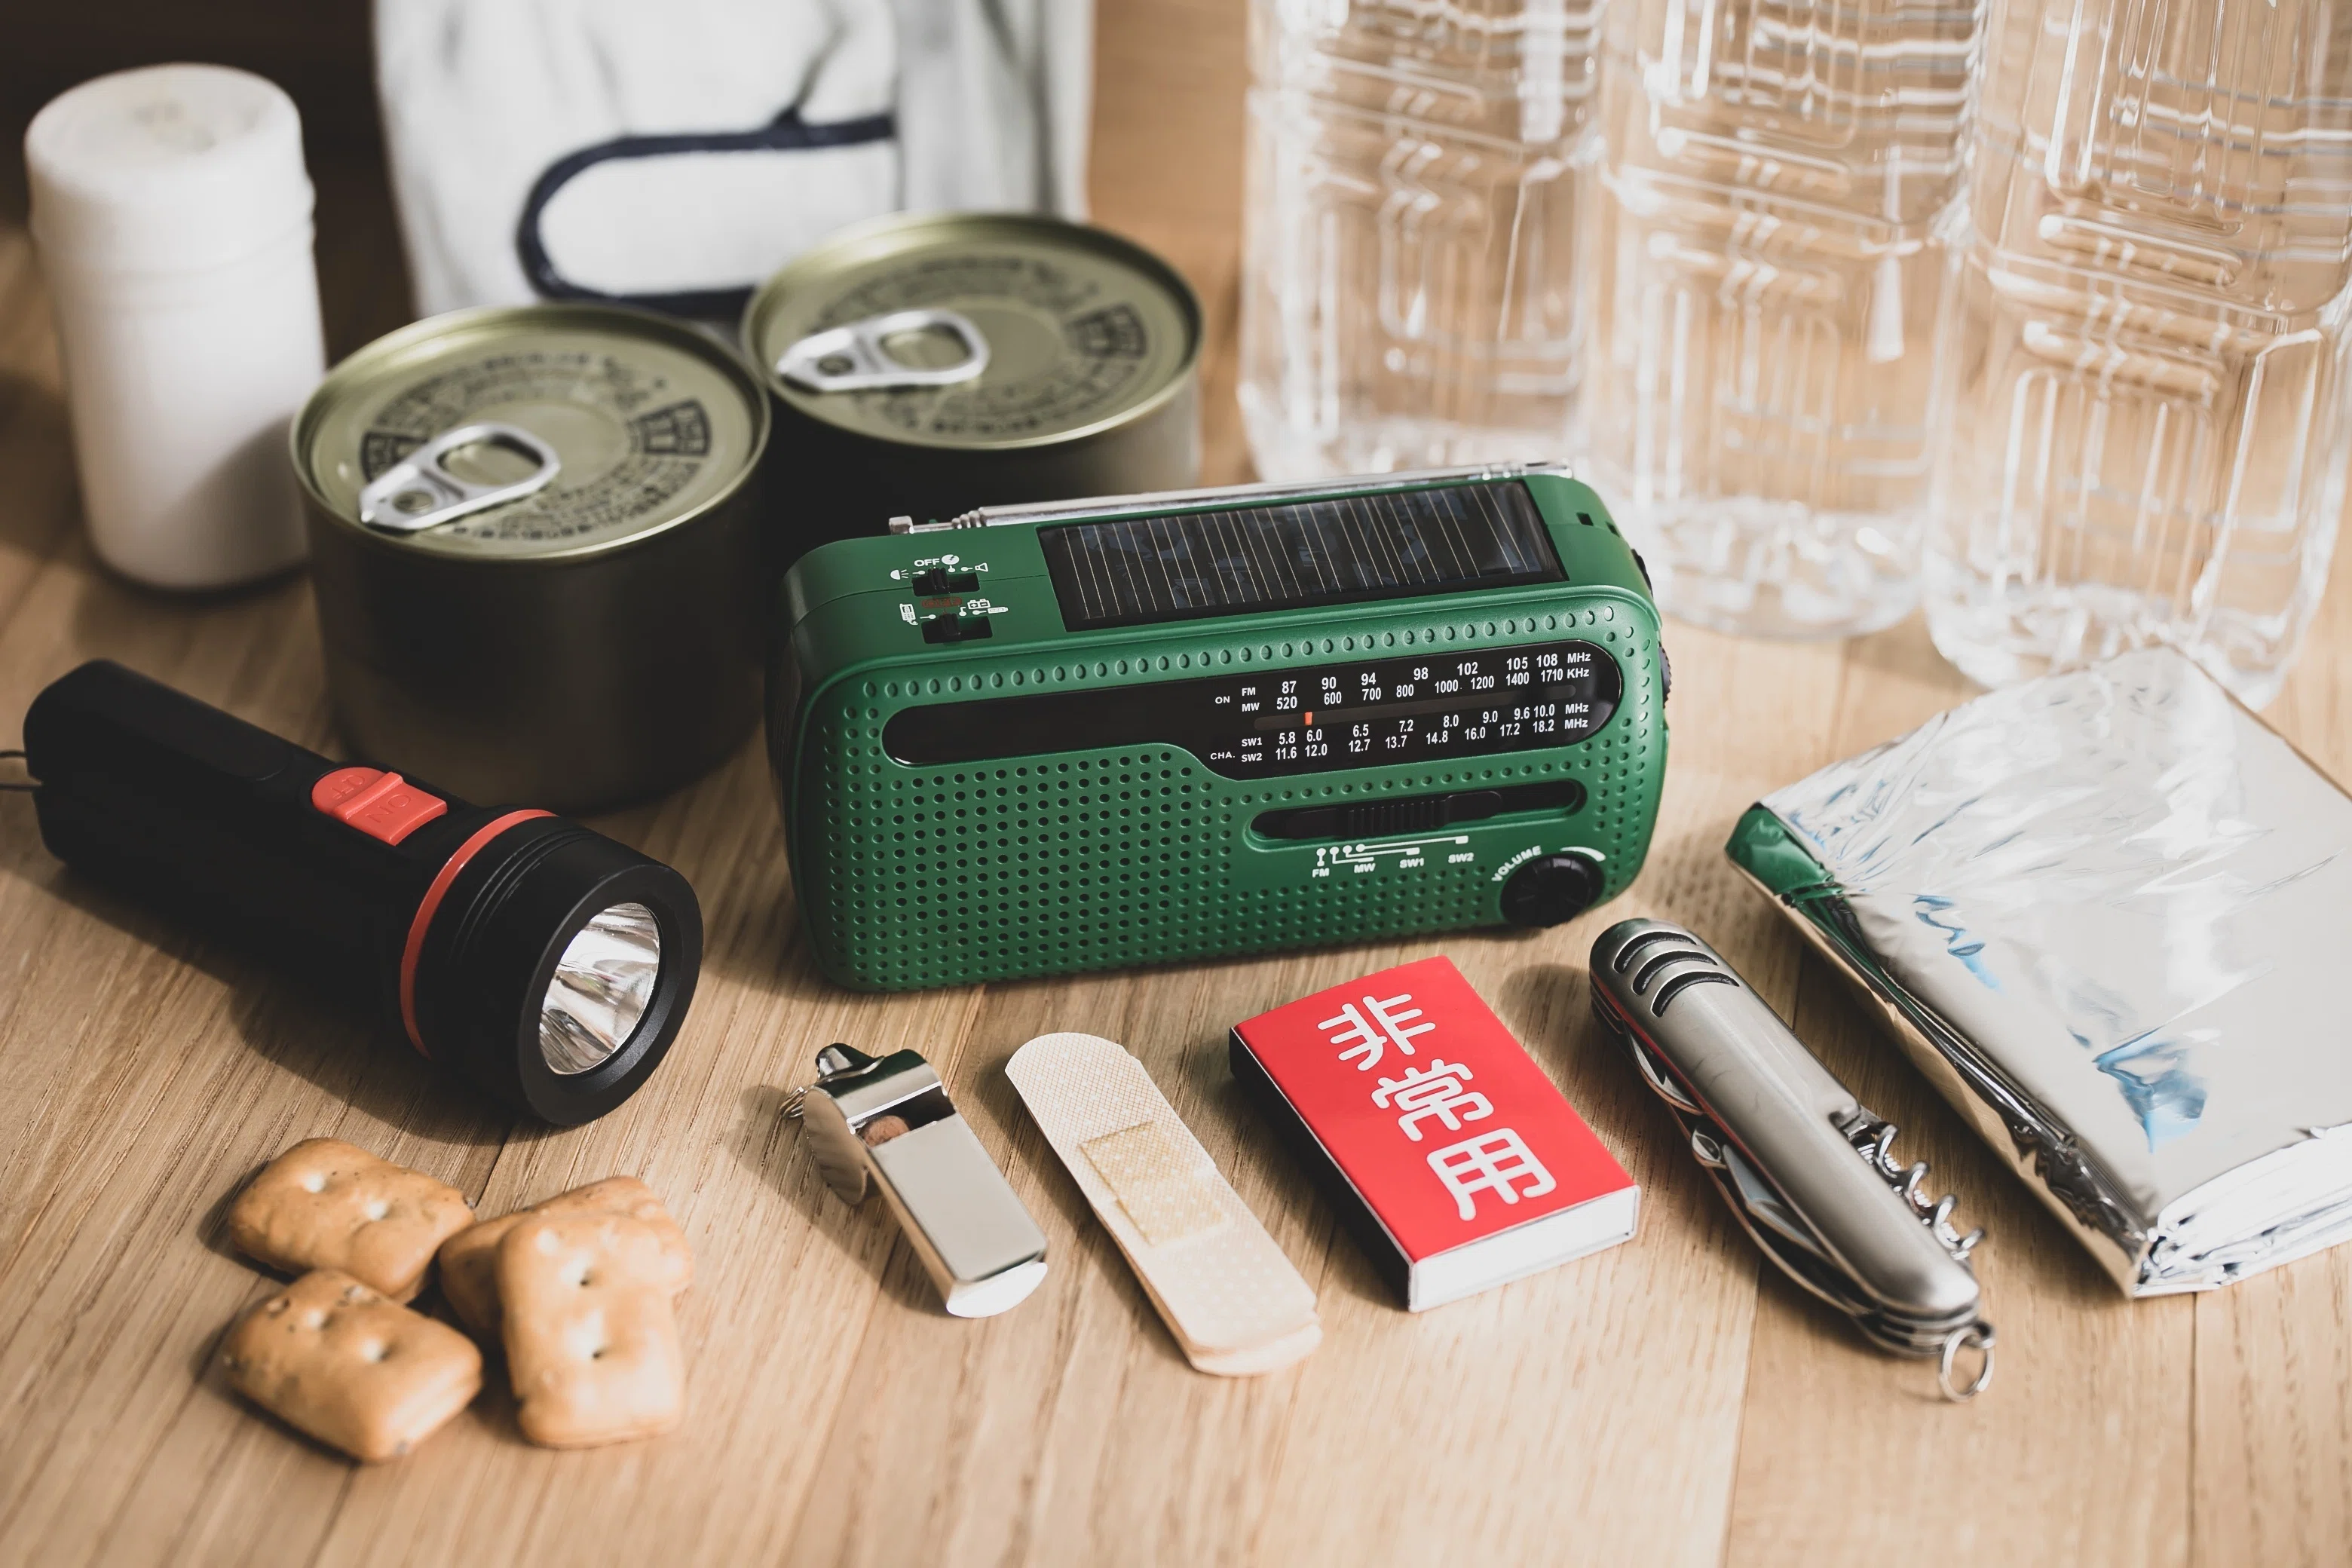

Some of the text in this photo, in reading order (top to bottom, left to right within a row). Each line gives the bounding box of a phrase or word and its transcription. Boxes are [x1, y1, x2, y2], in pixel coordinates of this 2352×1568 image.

[914, 558, 940, 567] OFF
[1242, 651, 1591, 697] FM 87 90 94 98 102 105 108 MHz
[1214, 695, 1230, 704] ON
[1242, 667, 1590, 712] MW 520 600 700 800 1000 1200 1400 1710 KHz
[1241, 703, 1589, 747] SW1 5.8 6.0 6.5 7.2 8.0 9.0 9.6 10.0 MHz
[1241, 718, 1588, 763] SW2 11.6 12.0 12.7 13.7 14.8 16.0 17.2 18.2 MHz
[1210, 751, 1236, 760] CHA.
[366, 793, 412, 823] ON
[1353, 862, 1376, 874] MW
[1399, 857, 1425, 869] SW1
[1447, 852, 1475, 864] SW2
[1491, 845, 1542, 881] VOLUME
[1312, 867, 1330, 878] FM
[1317, 993, 1557, 1221] 非常用
